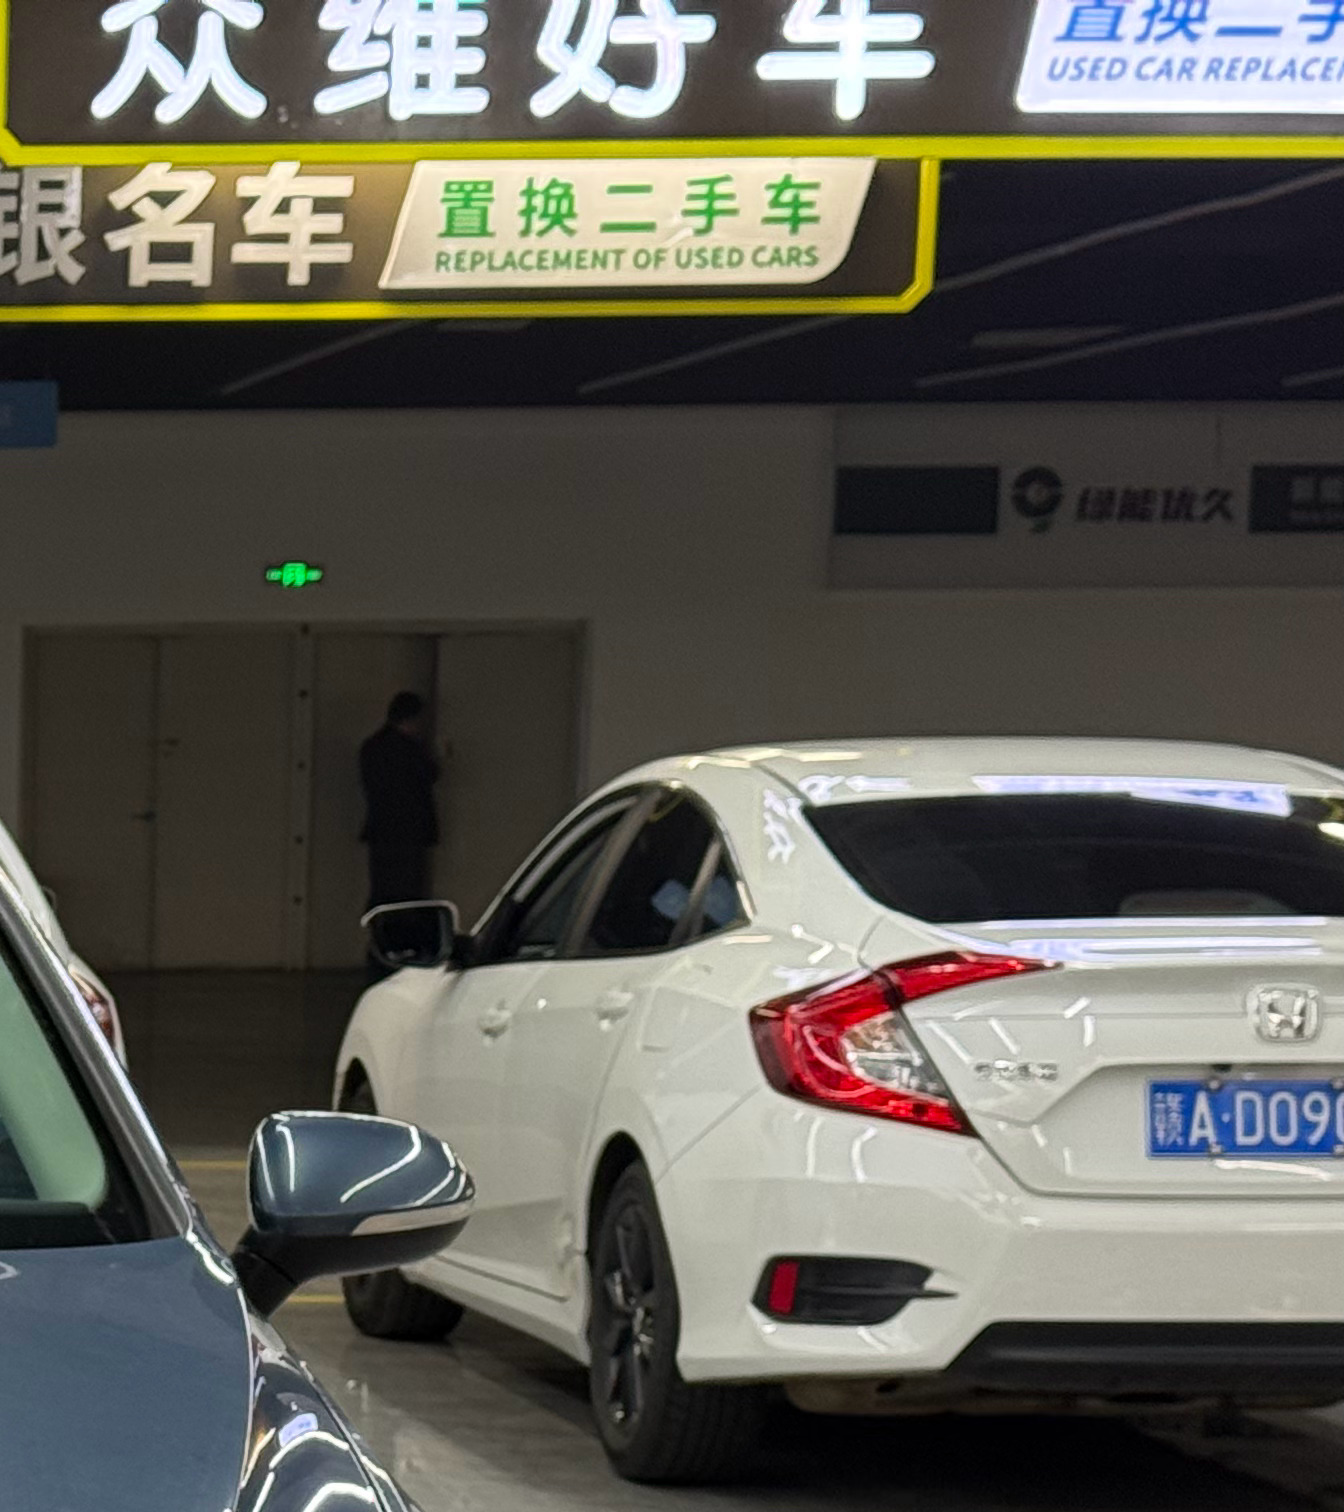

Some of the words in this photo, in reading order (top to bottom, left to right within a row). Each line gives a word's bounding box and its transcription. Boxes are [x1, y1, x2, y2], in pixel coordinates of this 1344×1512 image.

[1048, 56, 1127, 82] USED
[1134, 56, 1196, 82] CAR
[436, 173, 822, 239] 置换二手车
[434, 247, 626, 273] REPLACEMENT
[632, 247, 667, 271] OF
[674, 246, 745, 271] USED
[751, 245, 820, 269] CARS
[1153, 1090, 1344, 1147] 赣A·D09
